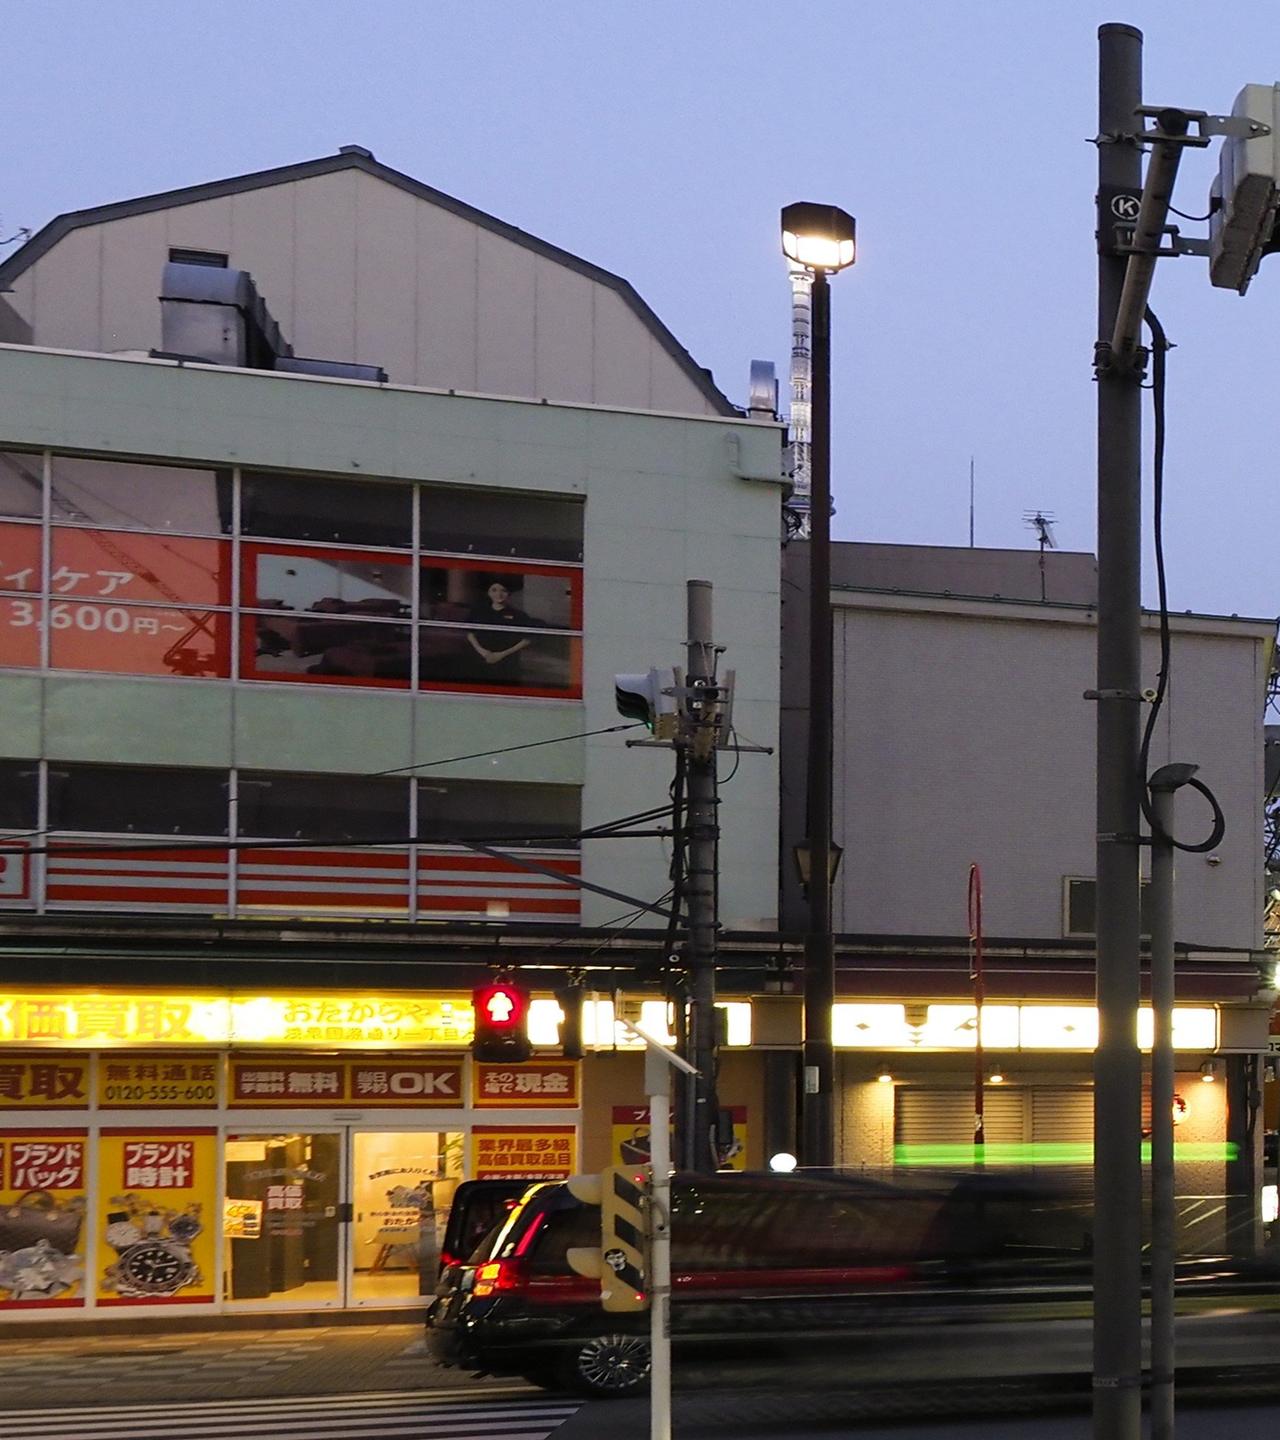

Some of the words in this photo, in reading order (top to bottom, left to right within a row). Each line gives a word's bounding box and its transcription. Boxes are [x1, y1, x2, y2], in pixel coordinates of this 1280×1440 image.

[0, 560, 135, 595] ィケア
[106, 1065, 215, 1081] 無料通話
[390, 1072, 455, 1094] OK
[514, 1073, 569, 1094] 現金
[105, 1086, 215, 1100] 0120-555-600
[14, 1143, 81, 1166] ブランド
[126, 1143, 191, 1165] ブランド
[478, 1153, 571, 1166] 高価買取品目
[14, 1167, 80, 1188] バッグ
[126, 1166, 189, 1187] 時計
